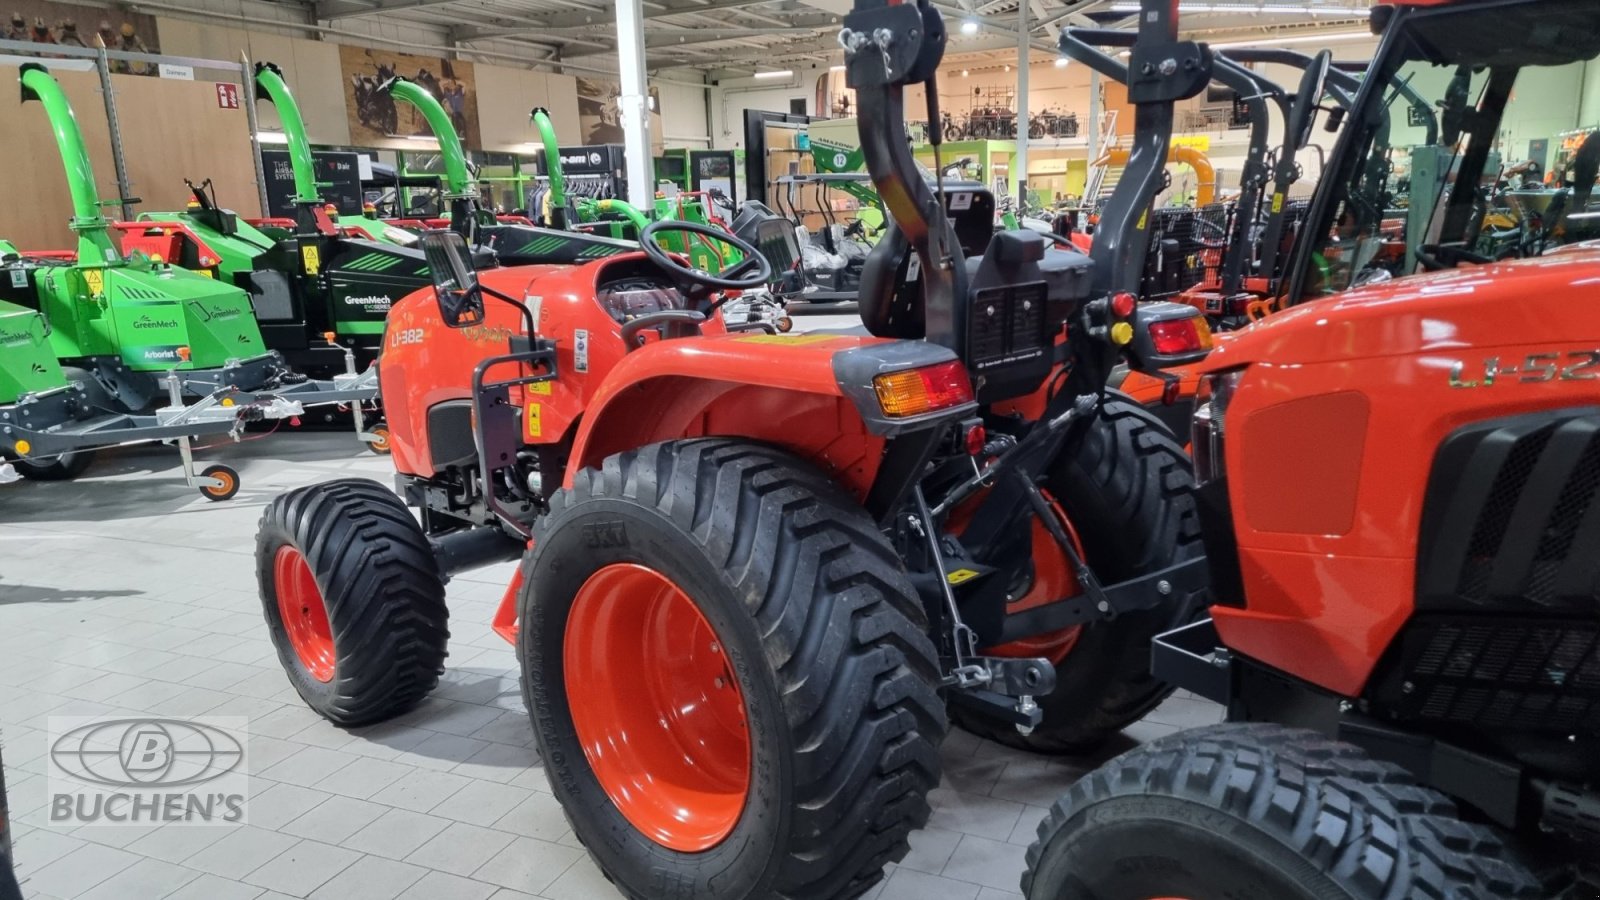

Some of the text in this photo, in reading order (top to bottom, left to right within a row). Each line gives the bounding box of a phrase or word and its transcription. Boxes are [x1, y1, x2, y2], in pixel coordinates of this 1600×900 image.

[836, 156, 845, 166] 12
[344, 294, 391, 305] GreenMech
[211, 307, 241, 319] GreenMech
[133, 320, 179, 329] GreenMech
[144, 350, 175, 359] Arborist
